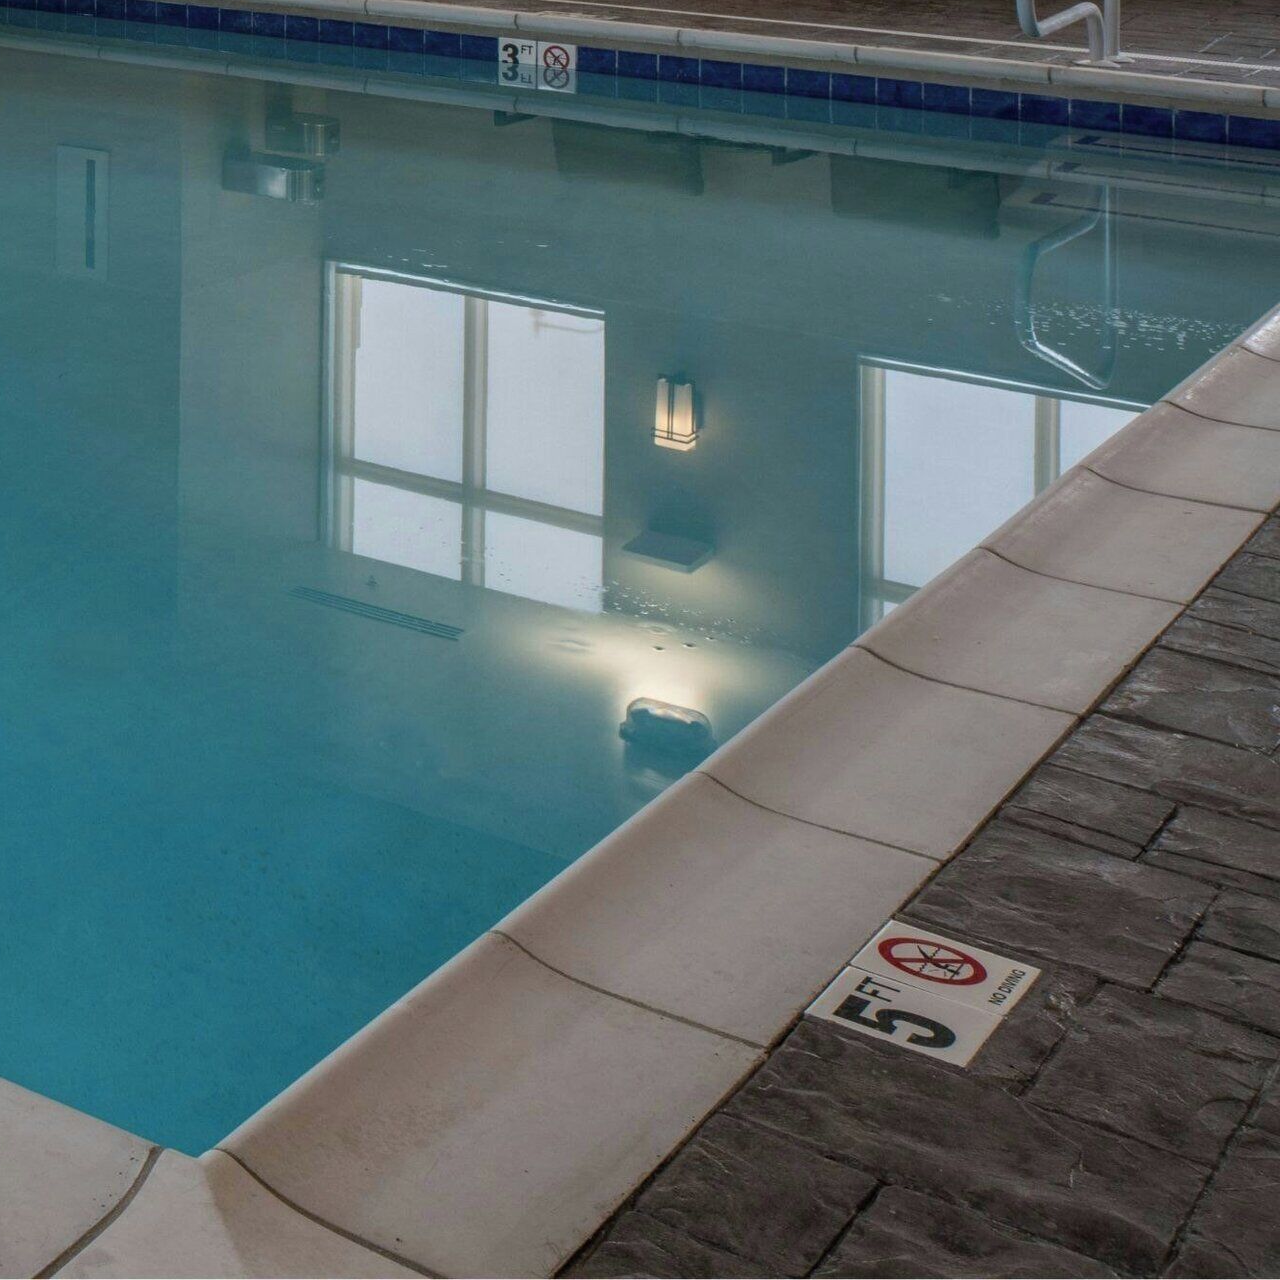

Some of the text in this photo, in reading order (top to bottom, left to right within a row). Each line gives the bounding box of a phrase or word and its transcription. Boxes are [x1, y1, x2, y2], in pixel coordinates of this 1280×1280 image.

[502, 43, 533, 64] 3 FT
[988, 969, 1026, 1006] NO DIVING
[833, 976, 956, 1049] 5 FT
